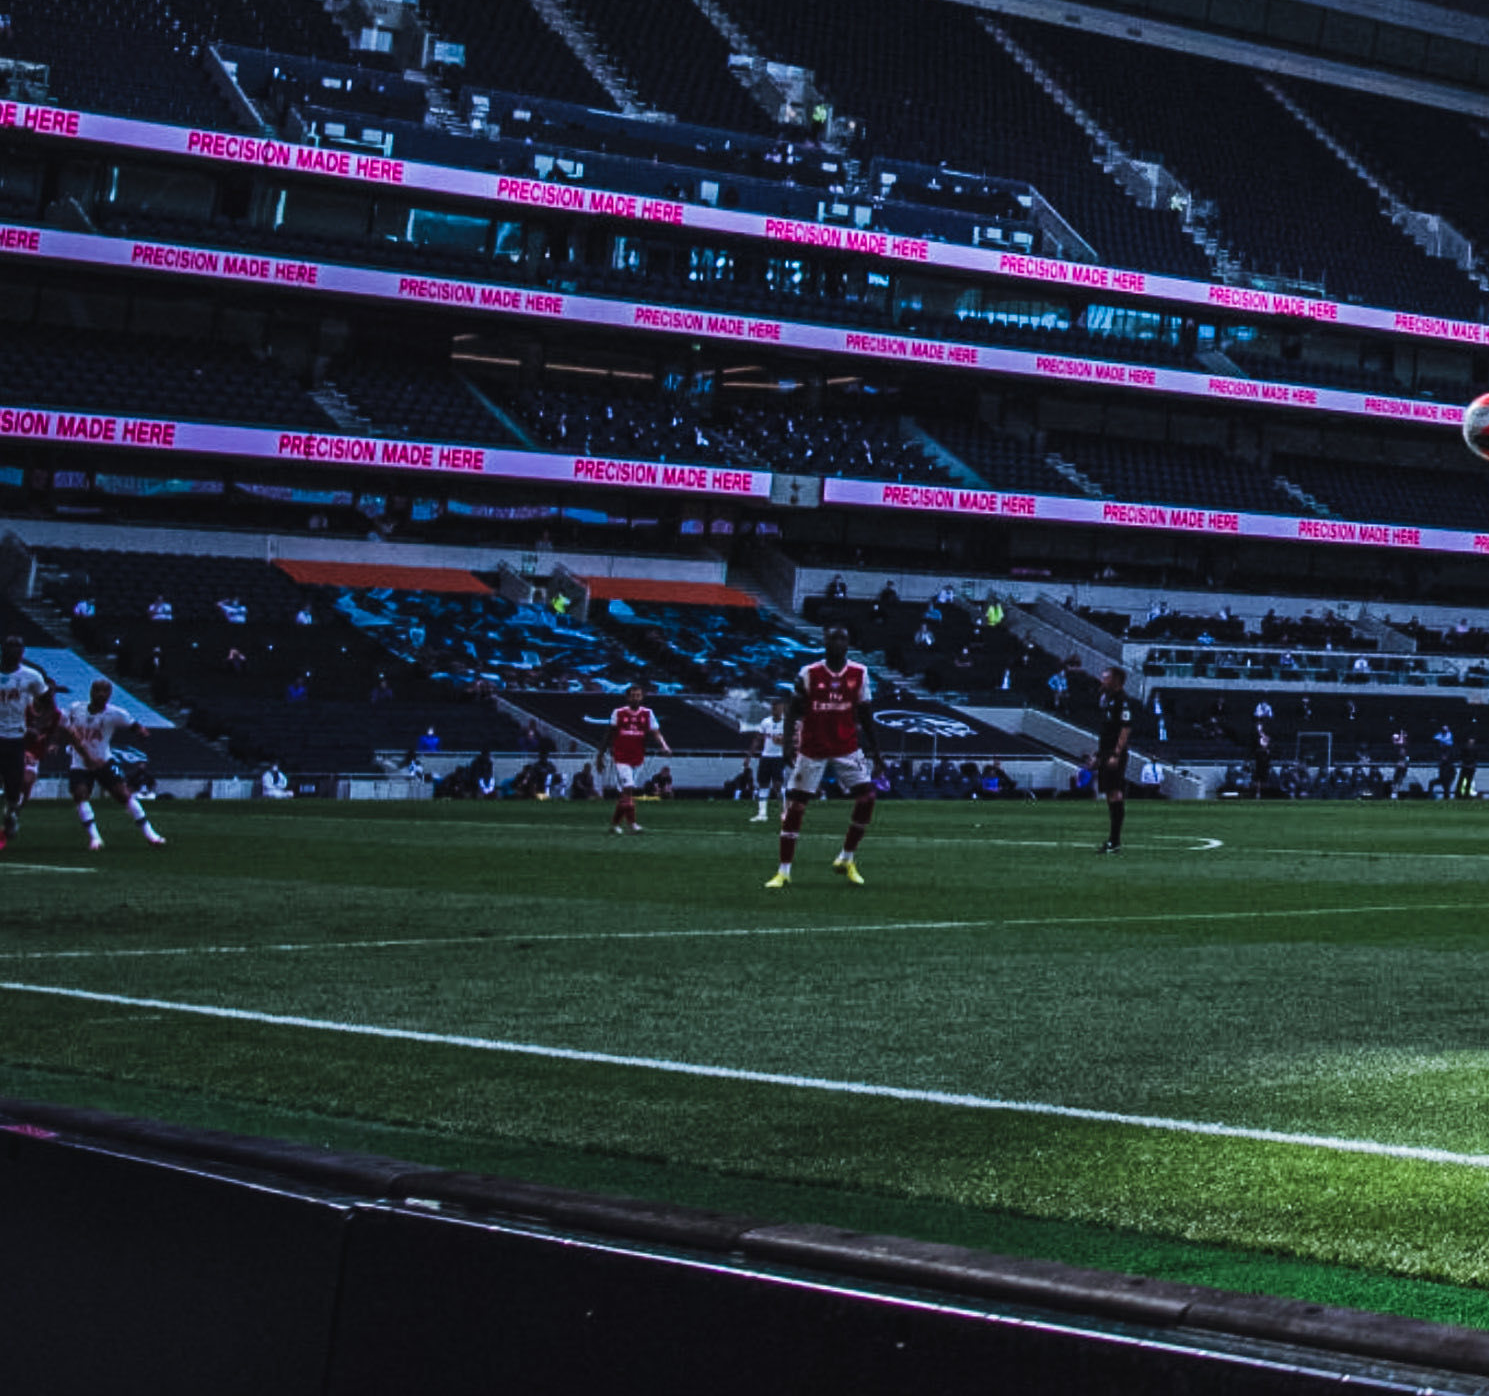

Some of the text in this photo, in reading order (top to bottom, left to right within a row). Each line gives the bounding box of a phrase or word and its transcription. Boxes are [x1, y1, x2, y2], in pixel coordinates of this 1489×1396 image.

[25, 108, 79, 136] HERE
[189, 132, 402, 183] PRECISION MADE HERE
[498, 178, 682, 225] PRECISION MADE HERE
[766, 220, 927, 260] PRECISION MADE HERE
[132, 245, 316, 285] PRECISION MADE HERE
[1000, 255, 1144, 294] PRECISION MADE HERE
[400, 279, 562, 314] PRECISION MADE HERE
[1210, 287, 1336, 322] PRECISION MADE HERE
[635, 308, 780, 340] PRECISION MADE HERE
[847, 334, 977, 364] PRECISION MADE HERE
[56, 416, 116, 441] MADE
[122, 422, 175, 445] HERE
[279, 434, 483, 472] PRECISION MADE HERE
[574, 459, 751, 494] PRECISION MADE HERE
[883, 487, 1034, 517] PRECISION MADE HERE
[1104, 505, 1238, 532] PRECISION MADE HERE
